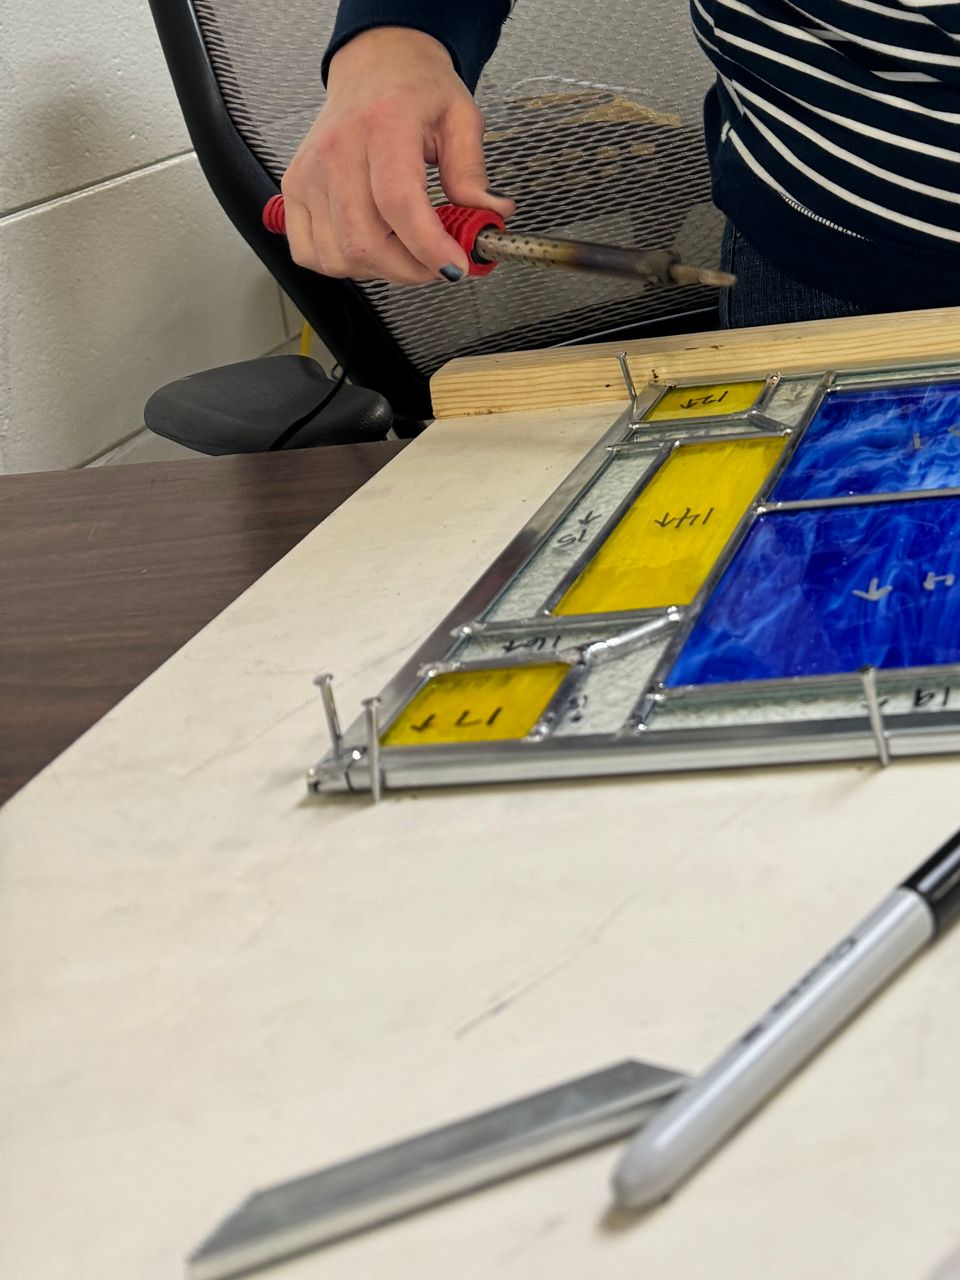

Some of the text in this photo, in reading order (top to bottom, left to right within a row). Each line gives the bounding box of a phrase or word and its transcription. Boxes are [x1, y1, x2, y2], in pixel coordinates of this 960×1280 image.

[702, 390, 728, 405] 12
[675, 507, 714, 528] 14
[557, 529, 587, 547] 15
[528, 635, 561, 650] 16
[914, 687, 949, 707] 19
[455, 706, 502, 726] 17
